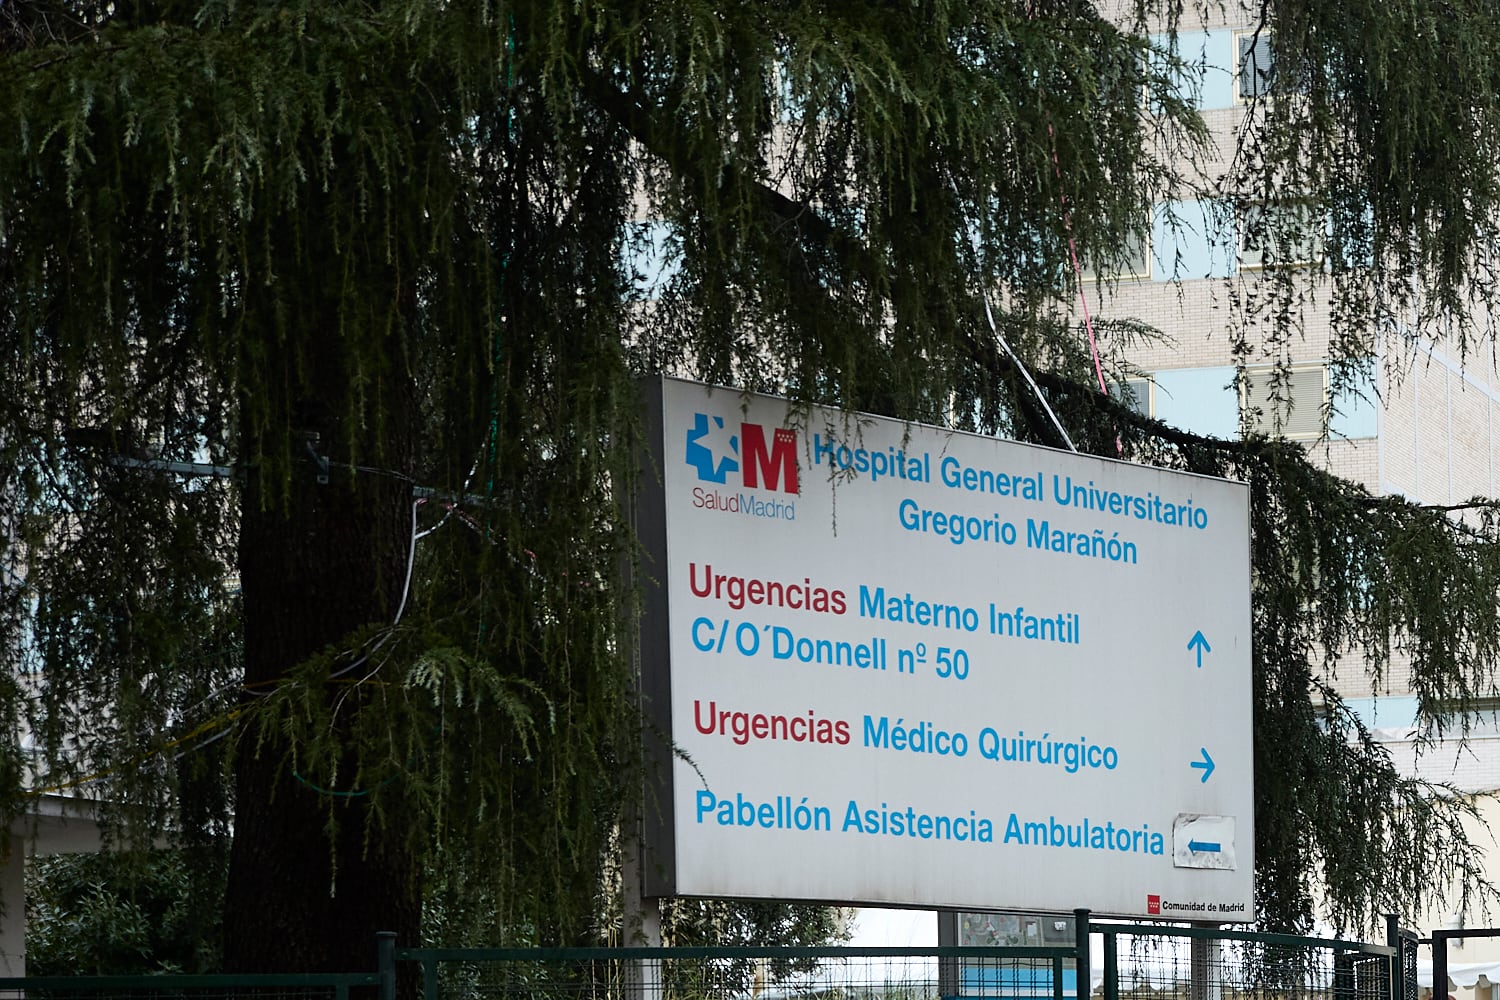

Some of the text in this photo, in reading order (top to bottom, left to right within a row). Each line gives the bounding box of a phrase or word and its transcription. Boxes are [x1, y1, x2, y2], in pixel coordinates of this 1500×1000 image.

[692, 487, 795, 520] SaludMadrid
[814, 432, 1209, 530] Hospital General Universitario
[898, 498, 1138, 565] Gregorio Marañón
[689, 562, 1080, 645] Urgencias Materno Infantil
[898, 642, 927, 675] nº
[935, 647, 970, 681] 50
[693, 700, 1118, 774] Urgencias Médico Quirúrgico
[696, 789, 1165, 856] Pabellón Asistencia Ambulatoria
[1162, 900, 1245, 913] Comunidad de Madrid
